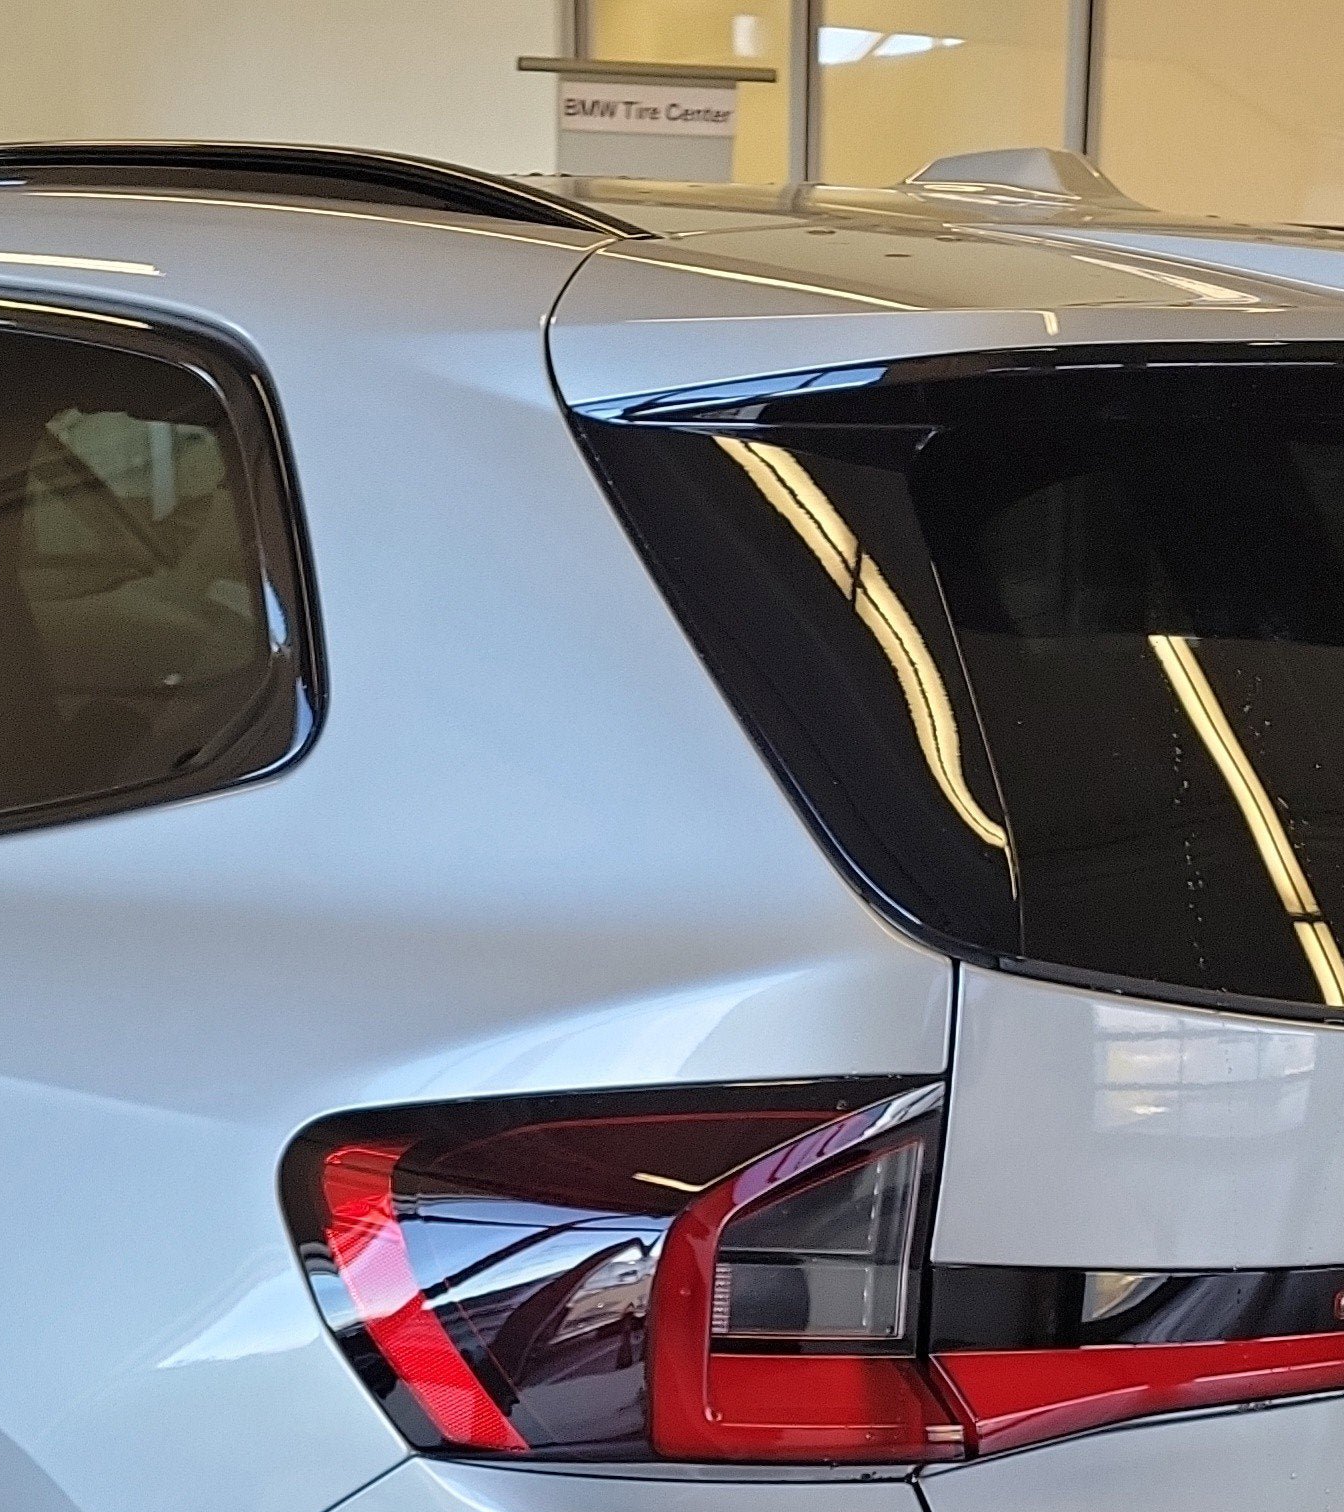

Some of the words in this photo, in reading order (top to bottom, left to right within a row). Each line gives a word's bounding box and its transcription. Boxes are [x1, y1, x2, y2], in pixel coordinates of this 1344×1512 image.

[563, 98, 617, 119] BMW
[622, 100, 660, 121] Tire
[665, 103, 734, 123] Center
